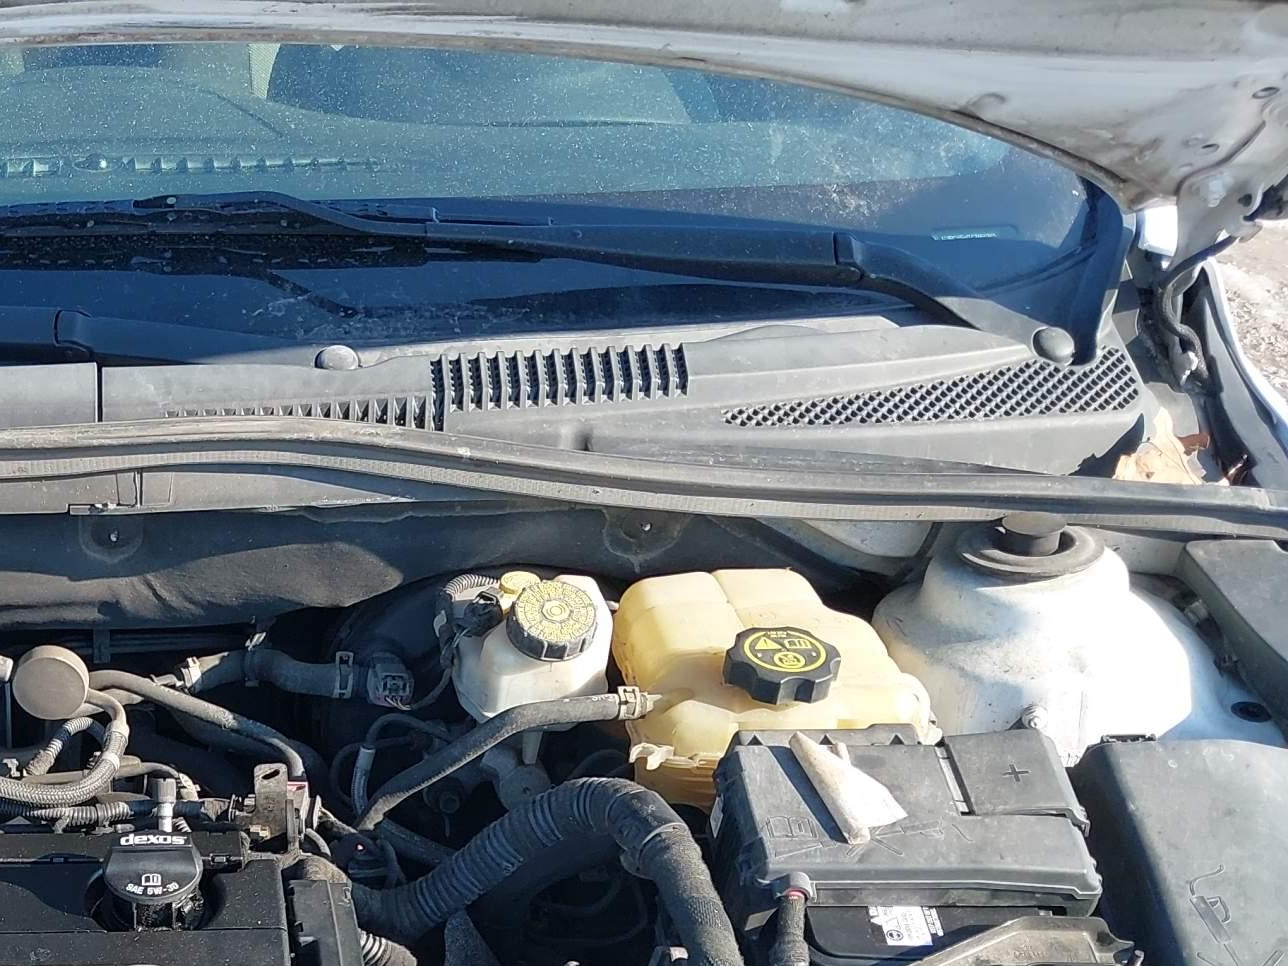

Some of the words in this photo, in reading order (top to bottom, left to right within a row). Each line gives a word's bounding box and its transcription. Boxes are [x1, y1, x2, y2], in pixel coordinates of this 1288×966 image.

[120, 833, 185, 844] dexos
[126, 883, 144, 894] SAE
[147, 882, 179, 895] 5W-30
